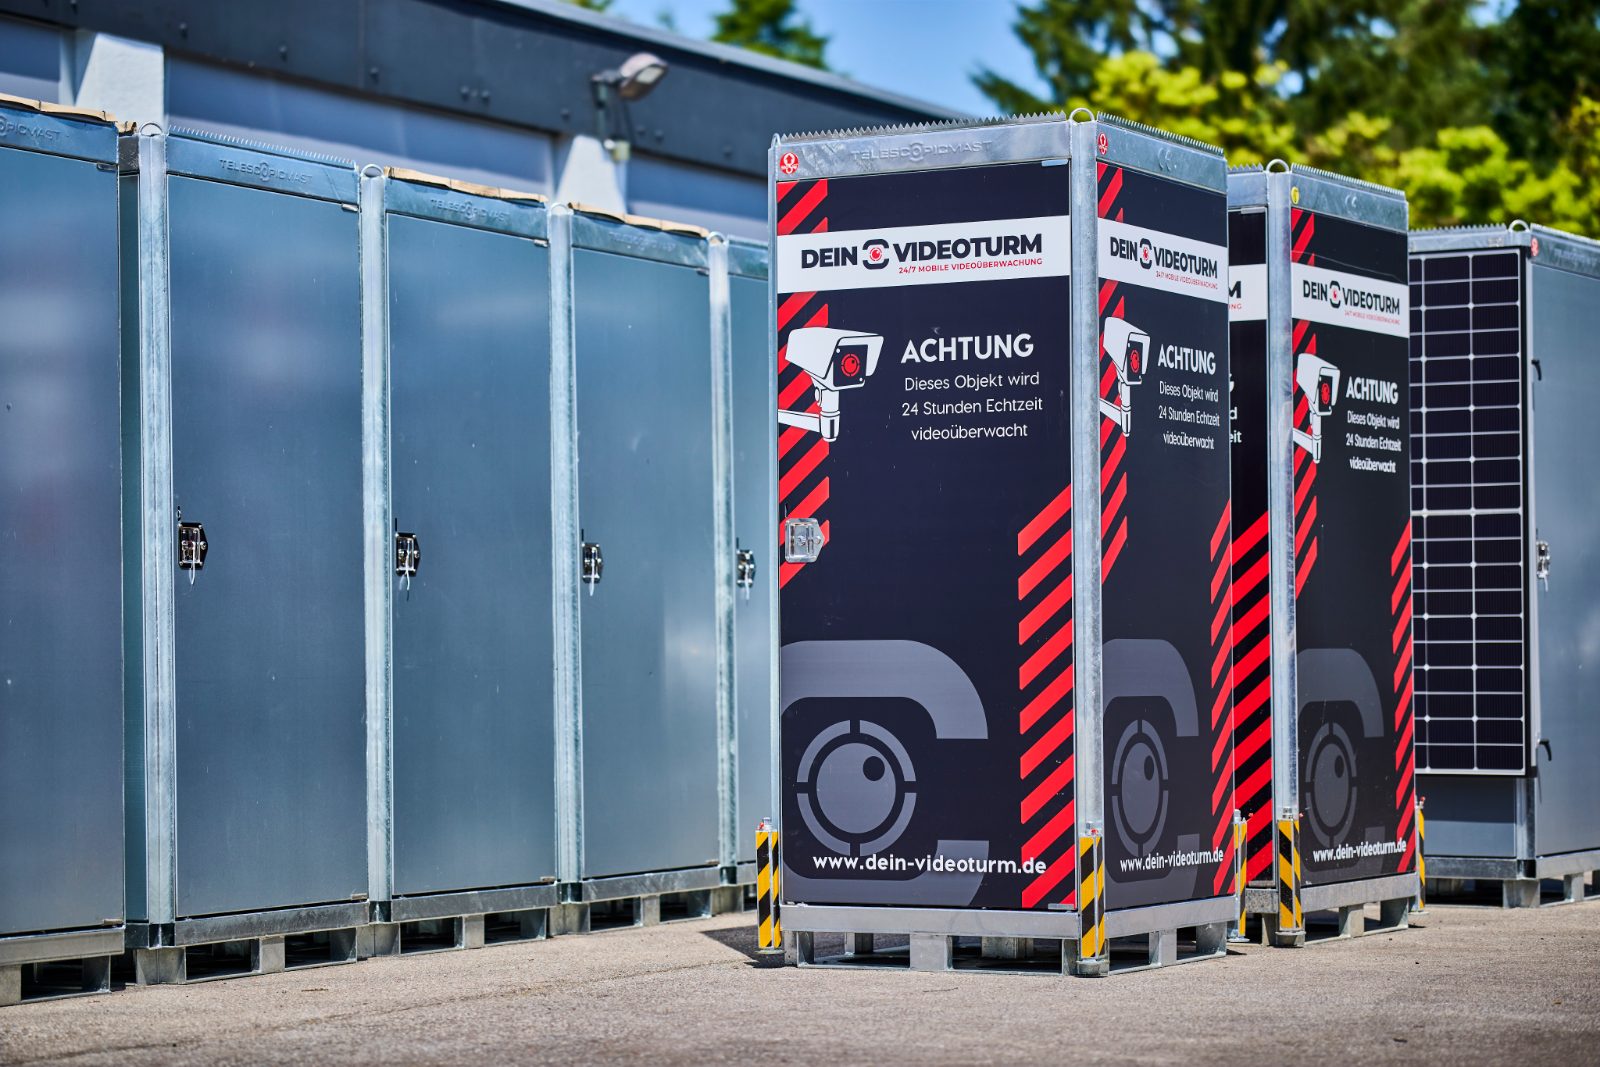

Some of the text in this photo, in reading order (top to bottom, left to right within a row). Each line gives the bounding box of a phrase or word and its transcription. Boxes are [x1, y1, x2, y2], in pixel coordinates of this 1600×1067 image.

[801, 233, 1042, 269] DEIN VIDEOTURM
[1110, 236, 1218, 279] DEIN VIDEOTURM
[899, 257, 1042, 275] 24/7 MOBILE VIDEOÜBERWACHUNG
[1303, 279, 1400, 316] DEIN VIDEOTURM
[901, 333, 1034, 364] ACHTUNG
[1157, 344, 1217, 375] ACHTUNG
[904, 372, 1040, 392] Dieses Objekt wird
[1159, 381, 1219, 403] Dieses Objekt wird
[1346, 376, 1399, 405] ACHTUNG
[901, 397, 1043, 416] 24 Stunden Echtzeit
[1158, 405, 1168, 419] 24
[1168, 407, 1196, 424] Stunden
[1196, 412, 1220, 427] Echtzeit
[1347, 410, 1400, 430] Dieses Objekt wird
[911, 424, 1028, 441] videoüberwacht
[1163, 431, 1215, 450] videoüberwacht
[1345, 433, 1401, 452] 24 Stunden Echtzeit
[1349, 456, 1396, 473] videoüberwacht
[1120, 846, 1224, 872] www.dein-videoturm.de
[1313, 837, 1407, 863] www.dein-videoturm.de
[813, 854, 1047, 874] www.dein-videoturm.de
